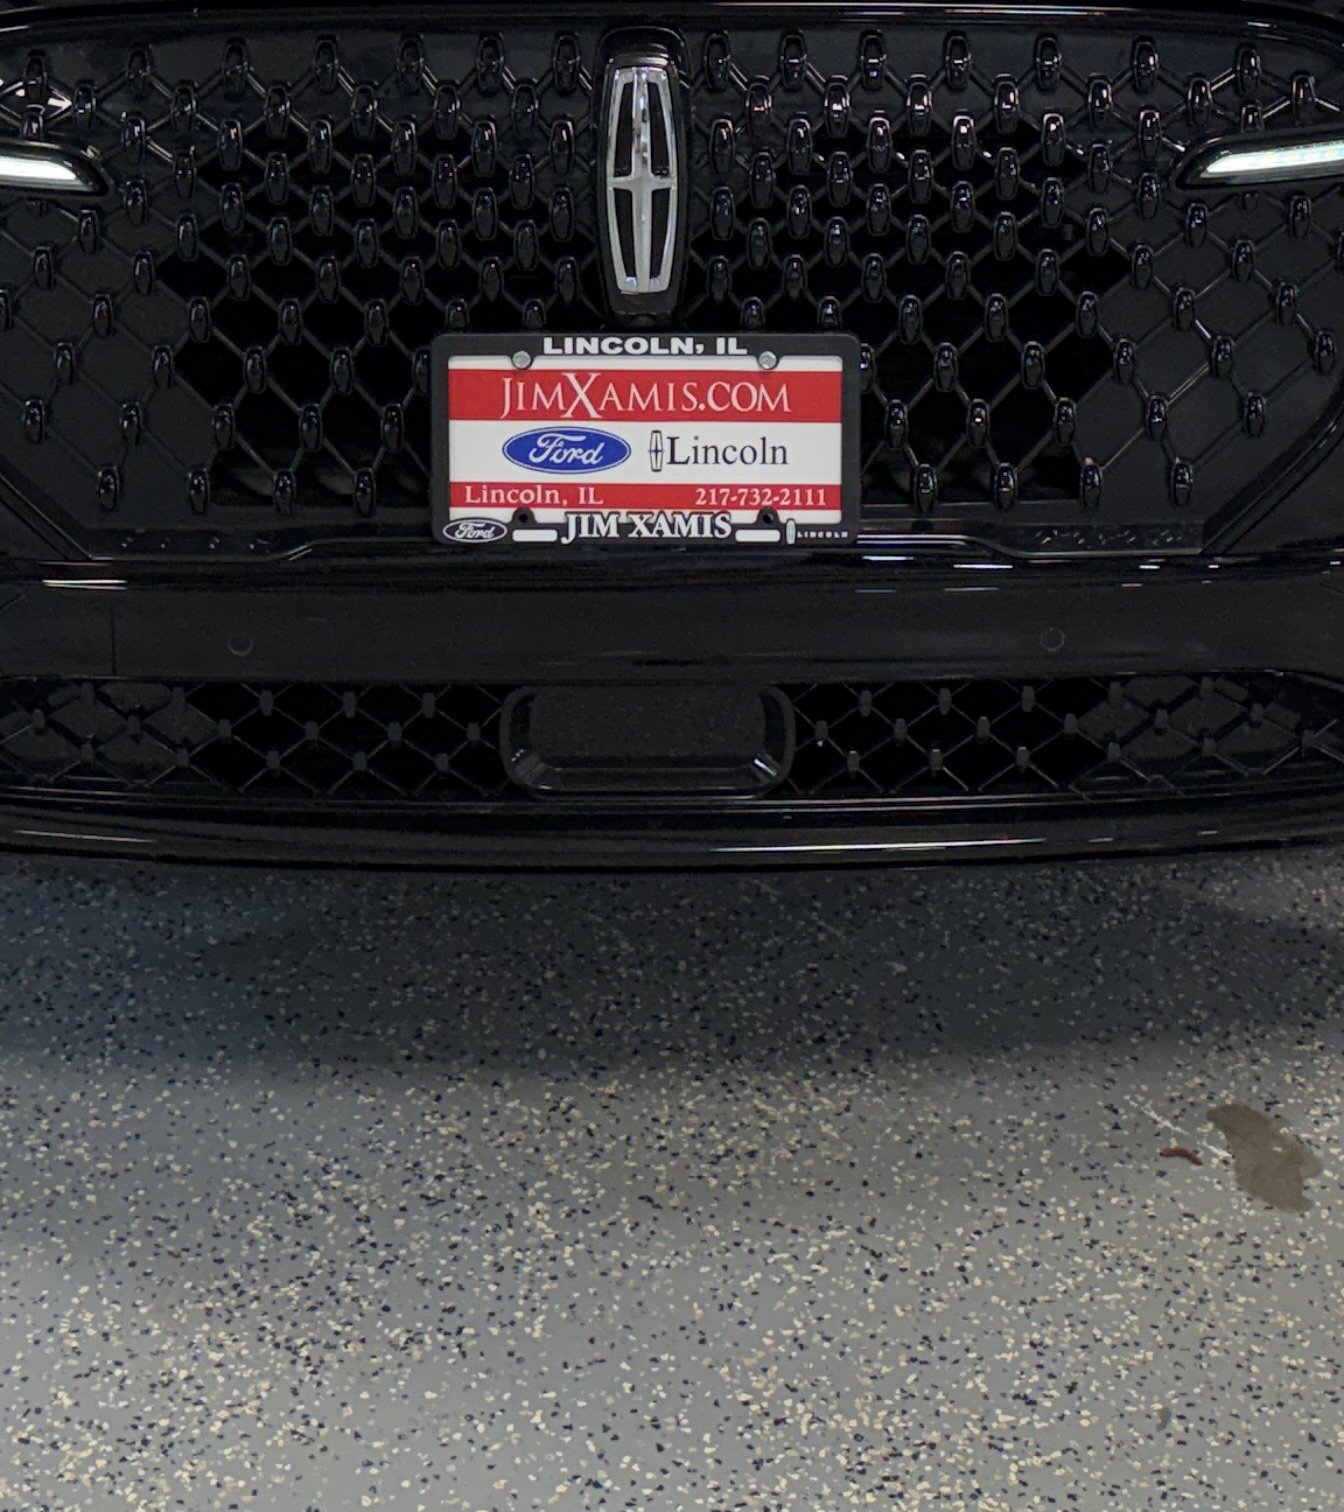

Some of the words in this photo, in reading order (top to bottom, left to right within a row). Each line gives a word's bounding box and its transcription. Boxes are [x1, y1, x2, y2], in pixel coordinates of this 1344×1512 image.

[543, 336, 706, 357] LINCOLN,
[713, 337, 751, 358] IL
[500, 372, 791, 419] JIMXAMIS.COM
[527, 433, 605, 466] Ford
[666, 435, 788, 465] Lincoln
[464, 483, 568, 507] Lincoln,
[578, 486, 604, 505] IL
[695, 487, 826, 507] 217-732-2111
[454, 522, 494, 539] Ford
[560, 513, 619, 544] JIM
[627, 513, 733, 539] XAMIS
[797, 531, 848, 539] LINCOLN
